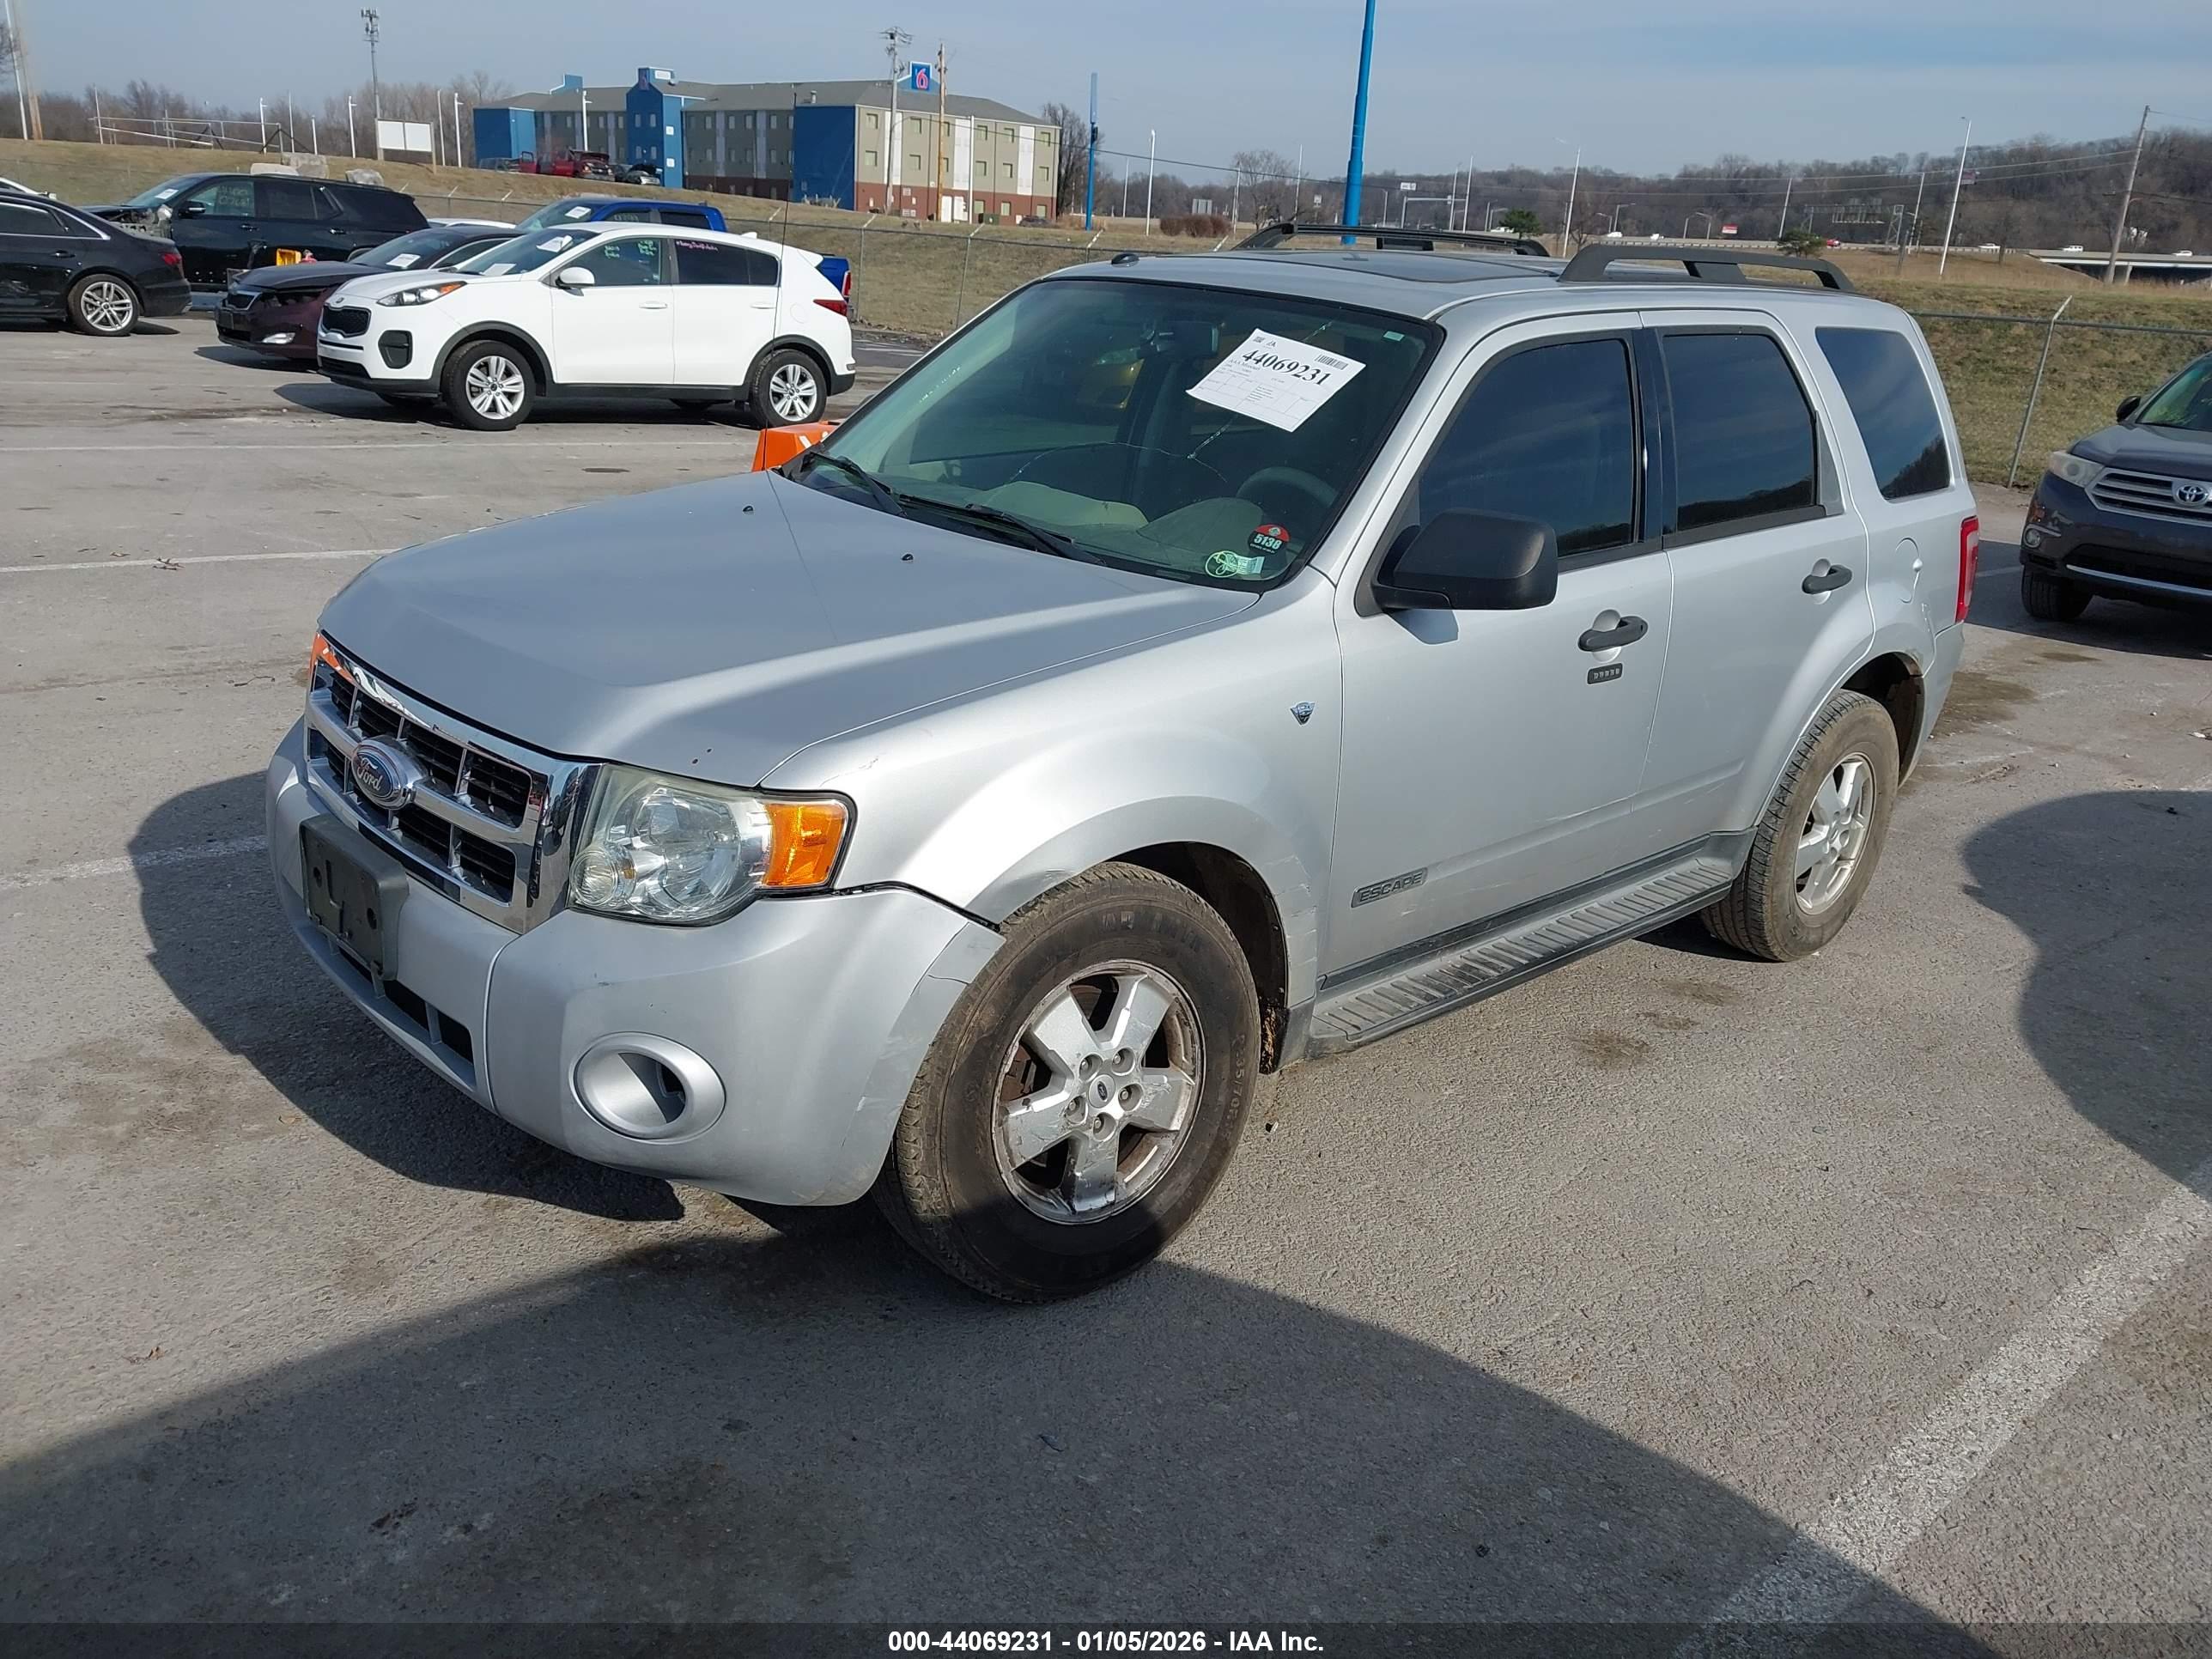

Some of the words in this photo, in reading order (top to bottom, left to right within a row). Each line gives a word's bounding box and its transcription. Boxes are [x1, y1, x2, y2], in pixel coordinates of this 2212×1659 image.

[915, 68, 928, 89] 6
[1242, 349, 1331, 386] 44069231
[356, 757, 381, 791] Ford
[1359, 871, 1423, 902] ESCAPE
